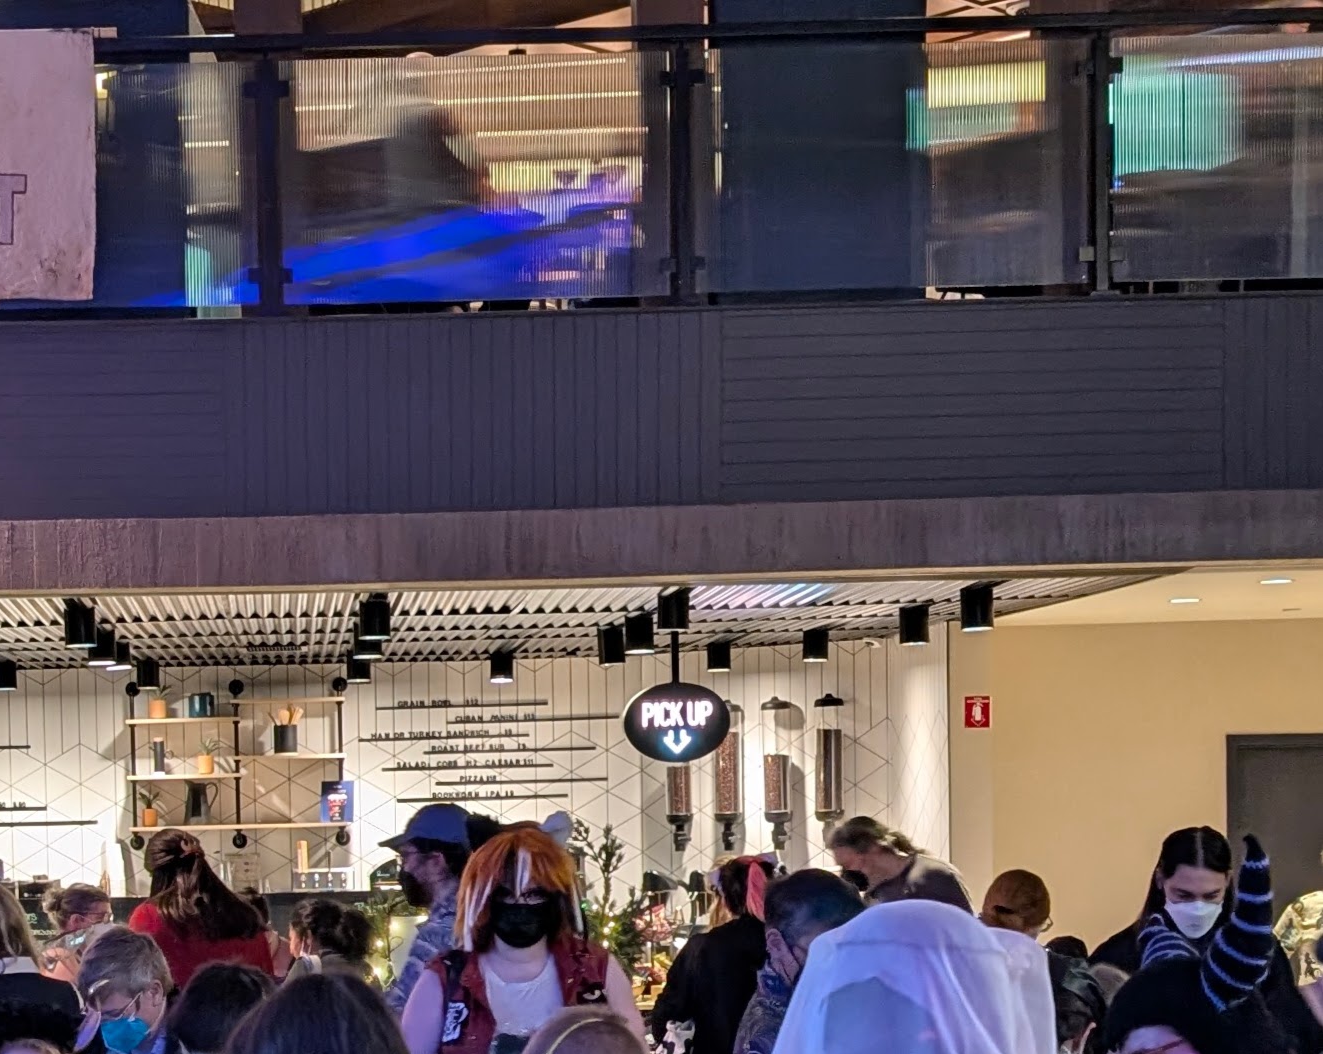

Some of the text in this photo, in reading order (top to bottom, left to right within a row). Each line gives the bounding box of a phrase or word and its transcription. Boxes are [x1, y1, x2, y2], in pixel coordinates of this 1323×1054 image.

[397, 700, 425, 708] GRAIN
[641, 700, 713, 727] PICK UP
[436, 760, 458, 768] COBB
[485, 759, 521, 767] CAESAR
[459, 775, 484, 783] PIZZA
